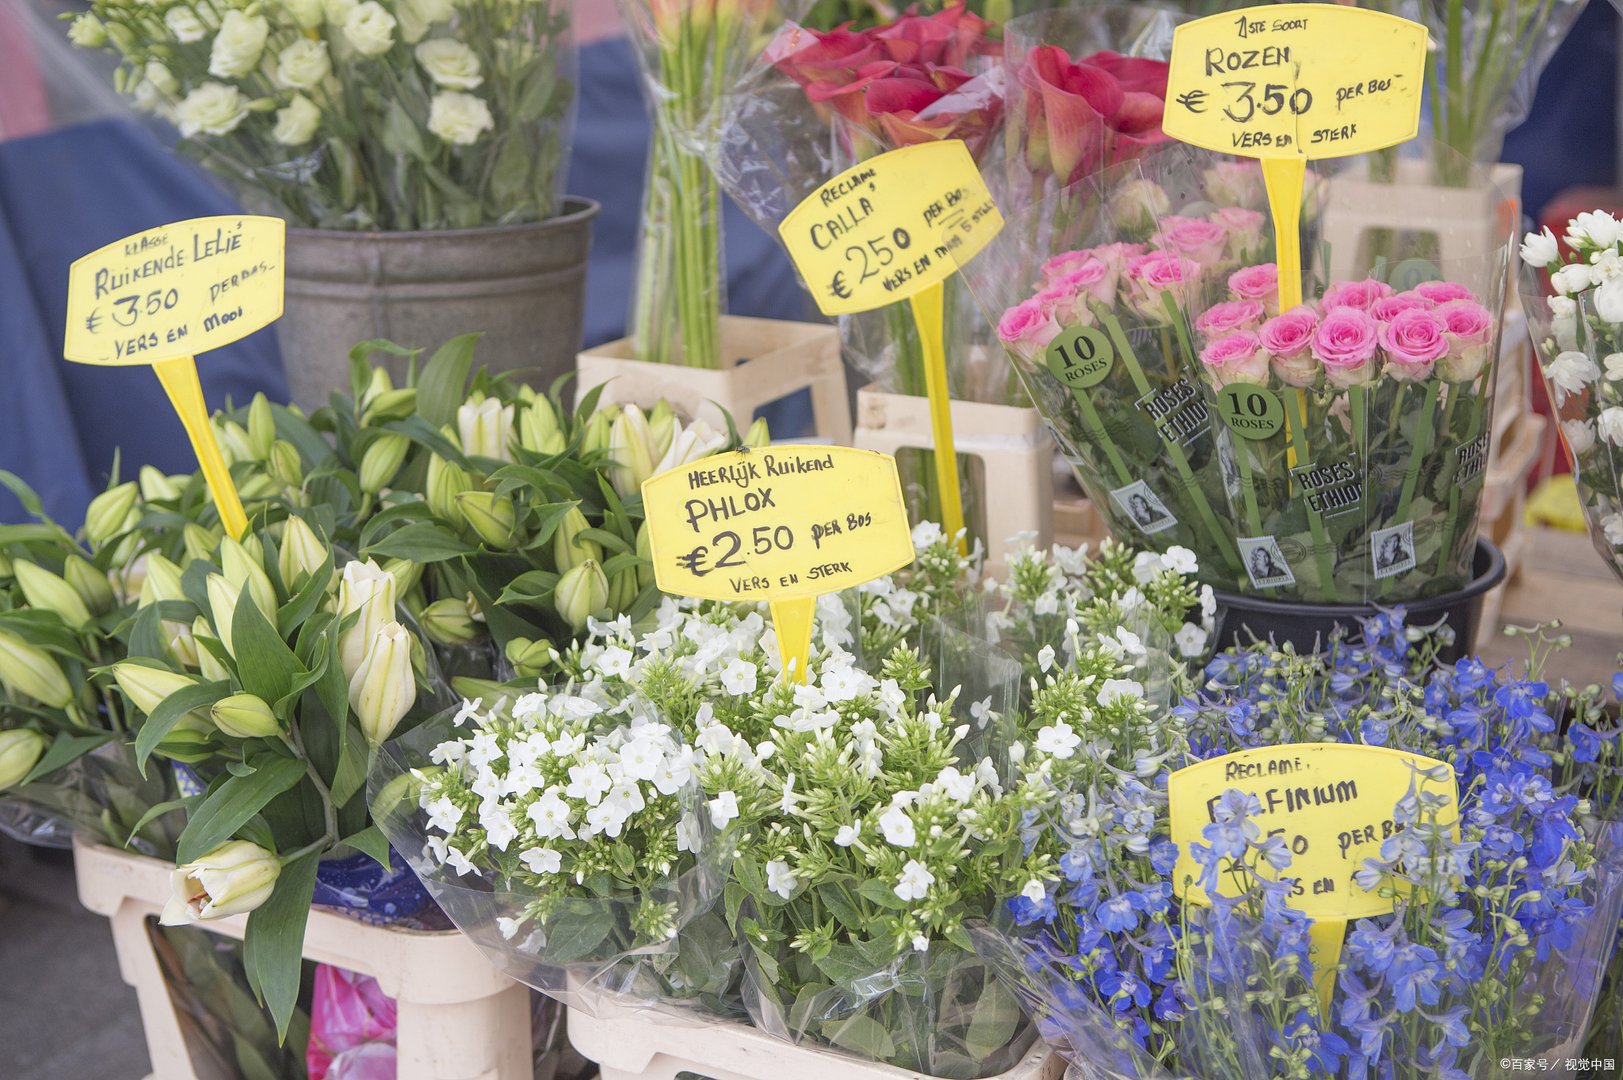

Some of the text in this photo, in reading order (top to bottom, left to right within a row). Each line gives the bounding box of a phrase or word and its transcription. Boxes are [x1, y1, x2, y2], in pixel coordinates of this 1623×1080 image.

[1272, 19, 1308, 32] SOORT
[1206, 46, 1290, 76] ROZEN
[1232, 131, 1272, 148] VERS
[1311, 124, 1356, 144] STERK
[923, 200, 945, 229] PER
[883, 255, 932, 292] VERS EN
[115, 332, 158, 360] VERS
[167, 325, 188, 343] EN
[1055, 336, 1096, 370] 10
[1064, 358, 1107, 382] ROSES
[1144, 378, 1196, 422] ROSES
[1228, 392, 1267, 416] 10
[1231, 417, 1274, 430] ROSES
[1298, 461, 1356, 490] ROSES
[684, 488, 776, 532] PHLOX
[811, 520, 842, 550] PER
[846, 512, 872, 532] BOS
[730, 562, 852, 592] VERS EN STERK
[1207, 780, 1358, 823] FINIUM
[1338, 825, 1378, 860] PER
[1313, 878, 1334, 894] EN
